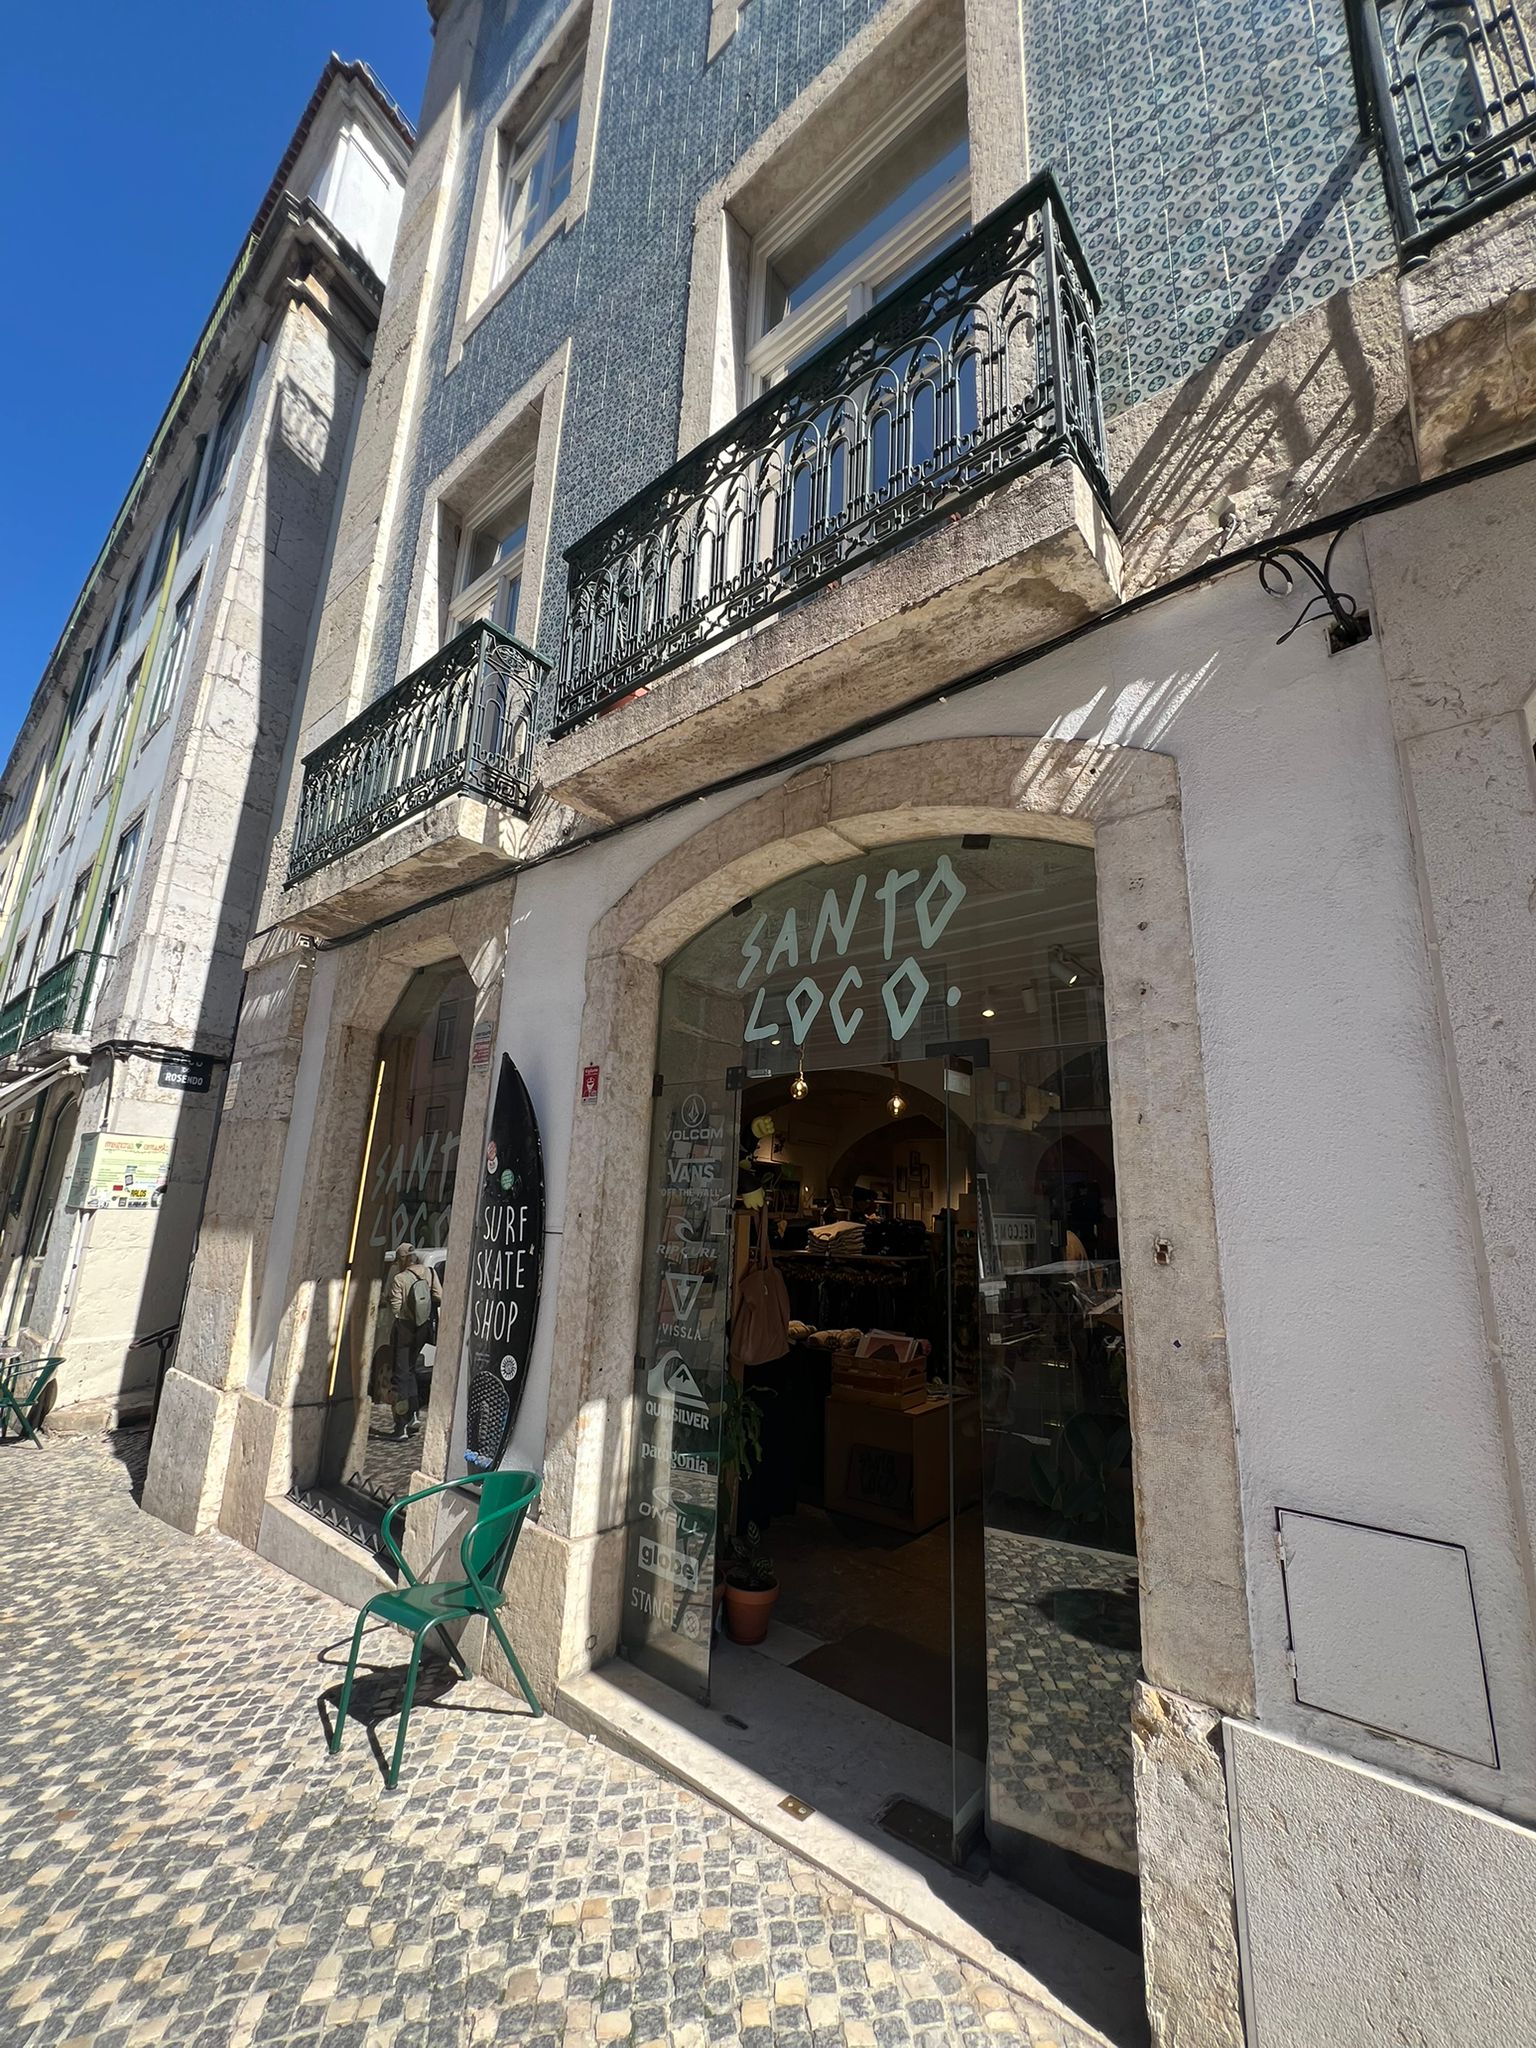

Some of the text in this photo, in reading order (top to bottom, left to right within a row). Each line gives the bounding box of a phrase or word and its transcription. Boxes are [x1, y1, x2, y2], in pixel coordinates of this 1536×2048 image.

[737, 854, 967, 989] SANTO
[743, 957, 962, 1046] LOCO.
[165, 1072, 204, 1086] ROSENDO
[664, 1128, 724, 1141] VOLCOM
[370, 1130, 460, 1202] SANT
[667, 1158, 715, 1183] VANS
[679, 1188, 694, 1197] THE
[483, 1206, 528, 1246] SURF
[476, 1249, 525, 1290] SKATE
[656, 1244, 719, 1259] RIP CURL
[473, 1301, 519, 1343] SHOP
[662, 1323, 703, 1341] VISSLA
[638, 1501, 708, 1539] O'NEILL
[641, 1544, 696, 1582] globe
[630, 1586, 679, 1628] STANCE
